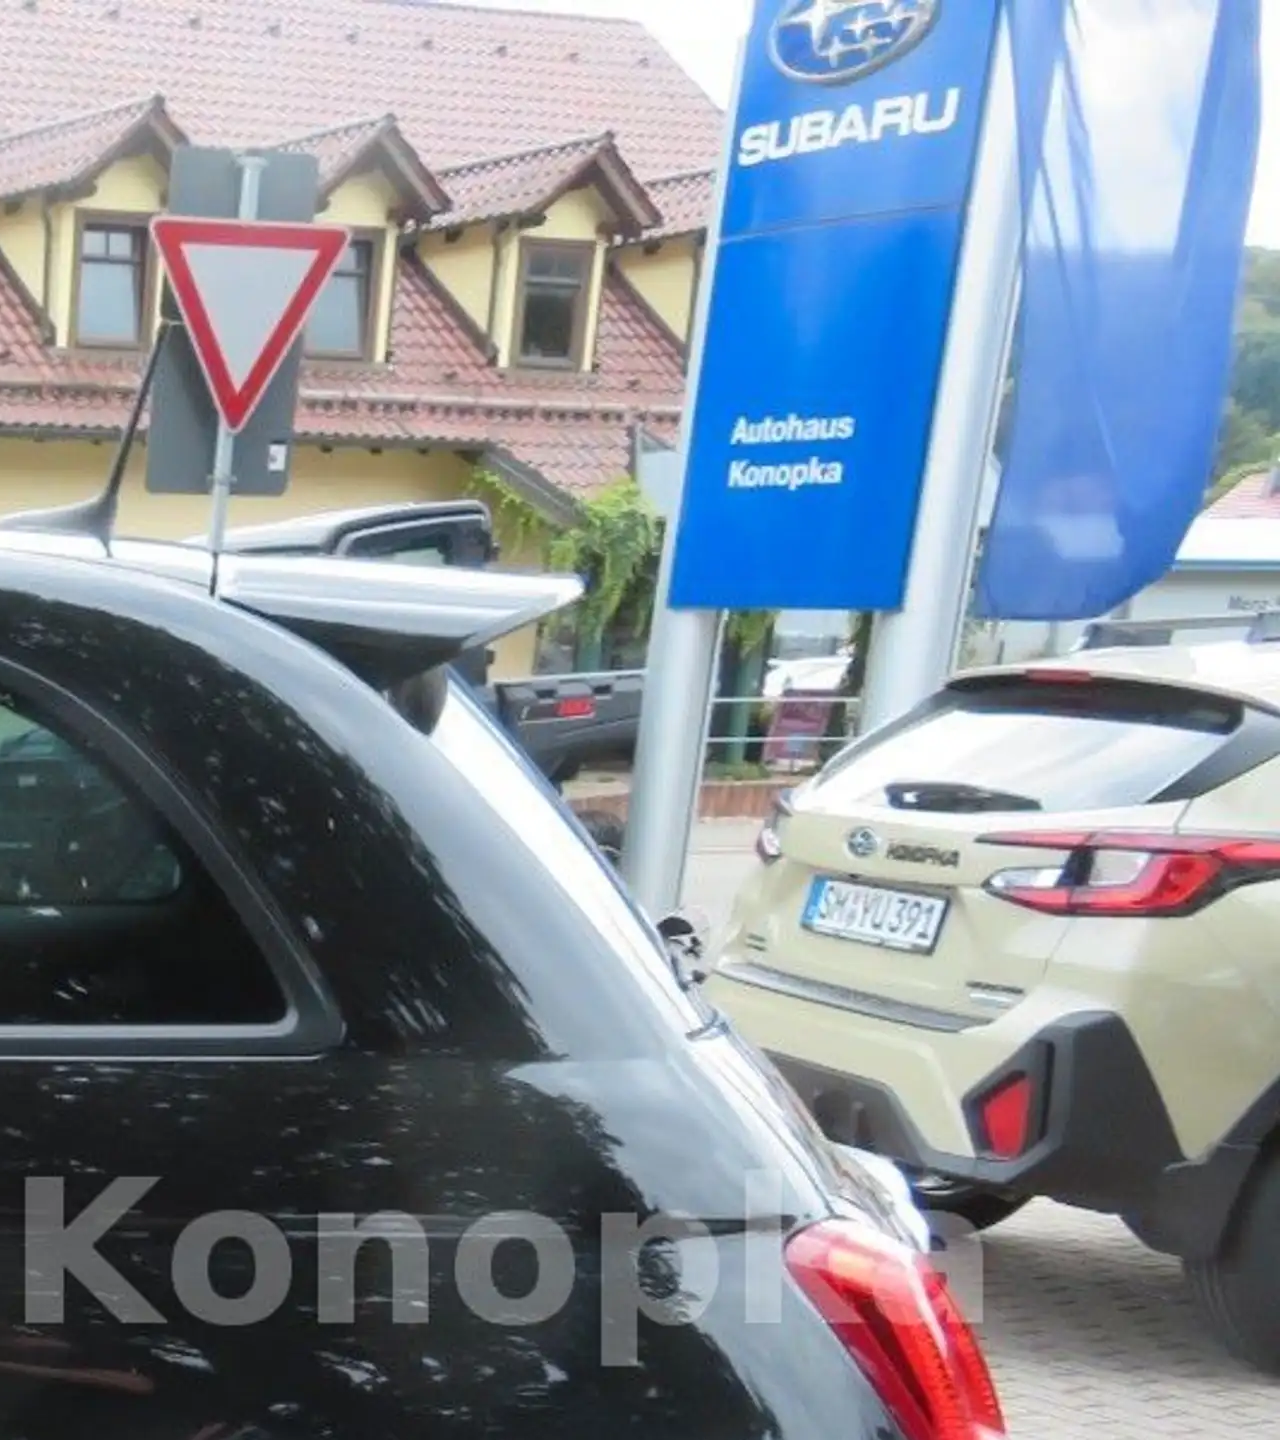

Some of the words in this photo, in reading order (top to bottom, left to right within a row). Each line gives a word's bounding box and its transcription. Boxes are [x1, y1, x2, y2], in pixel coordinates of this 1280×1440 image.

[738, 87, 961, 167] SUBARU
[730, 413, 856, 445] Autohaus
[728, 456, 843, 491] Konopka
